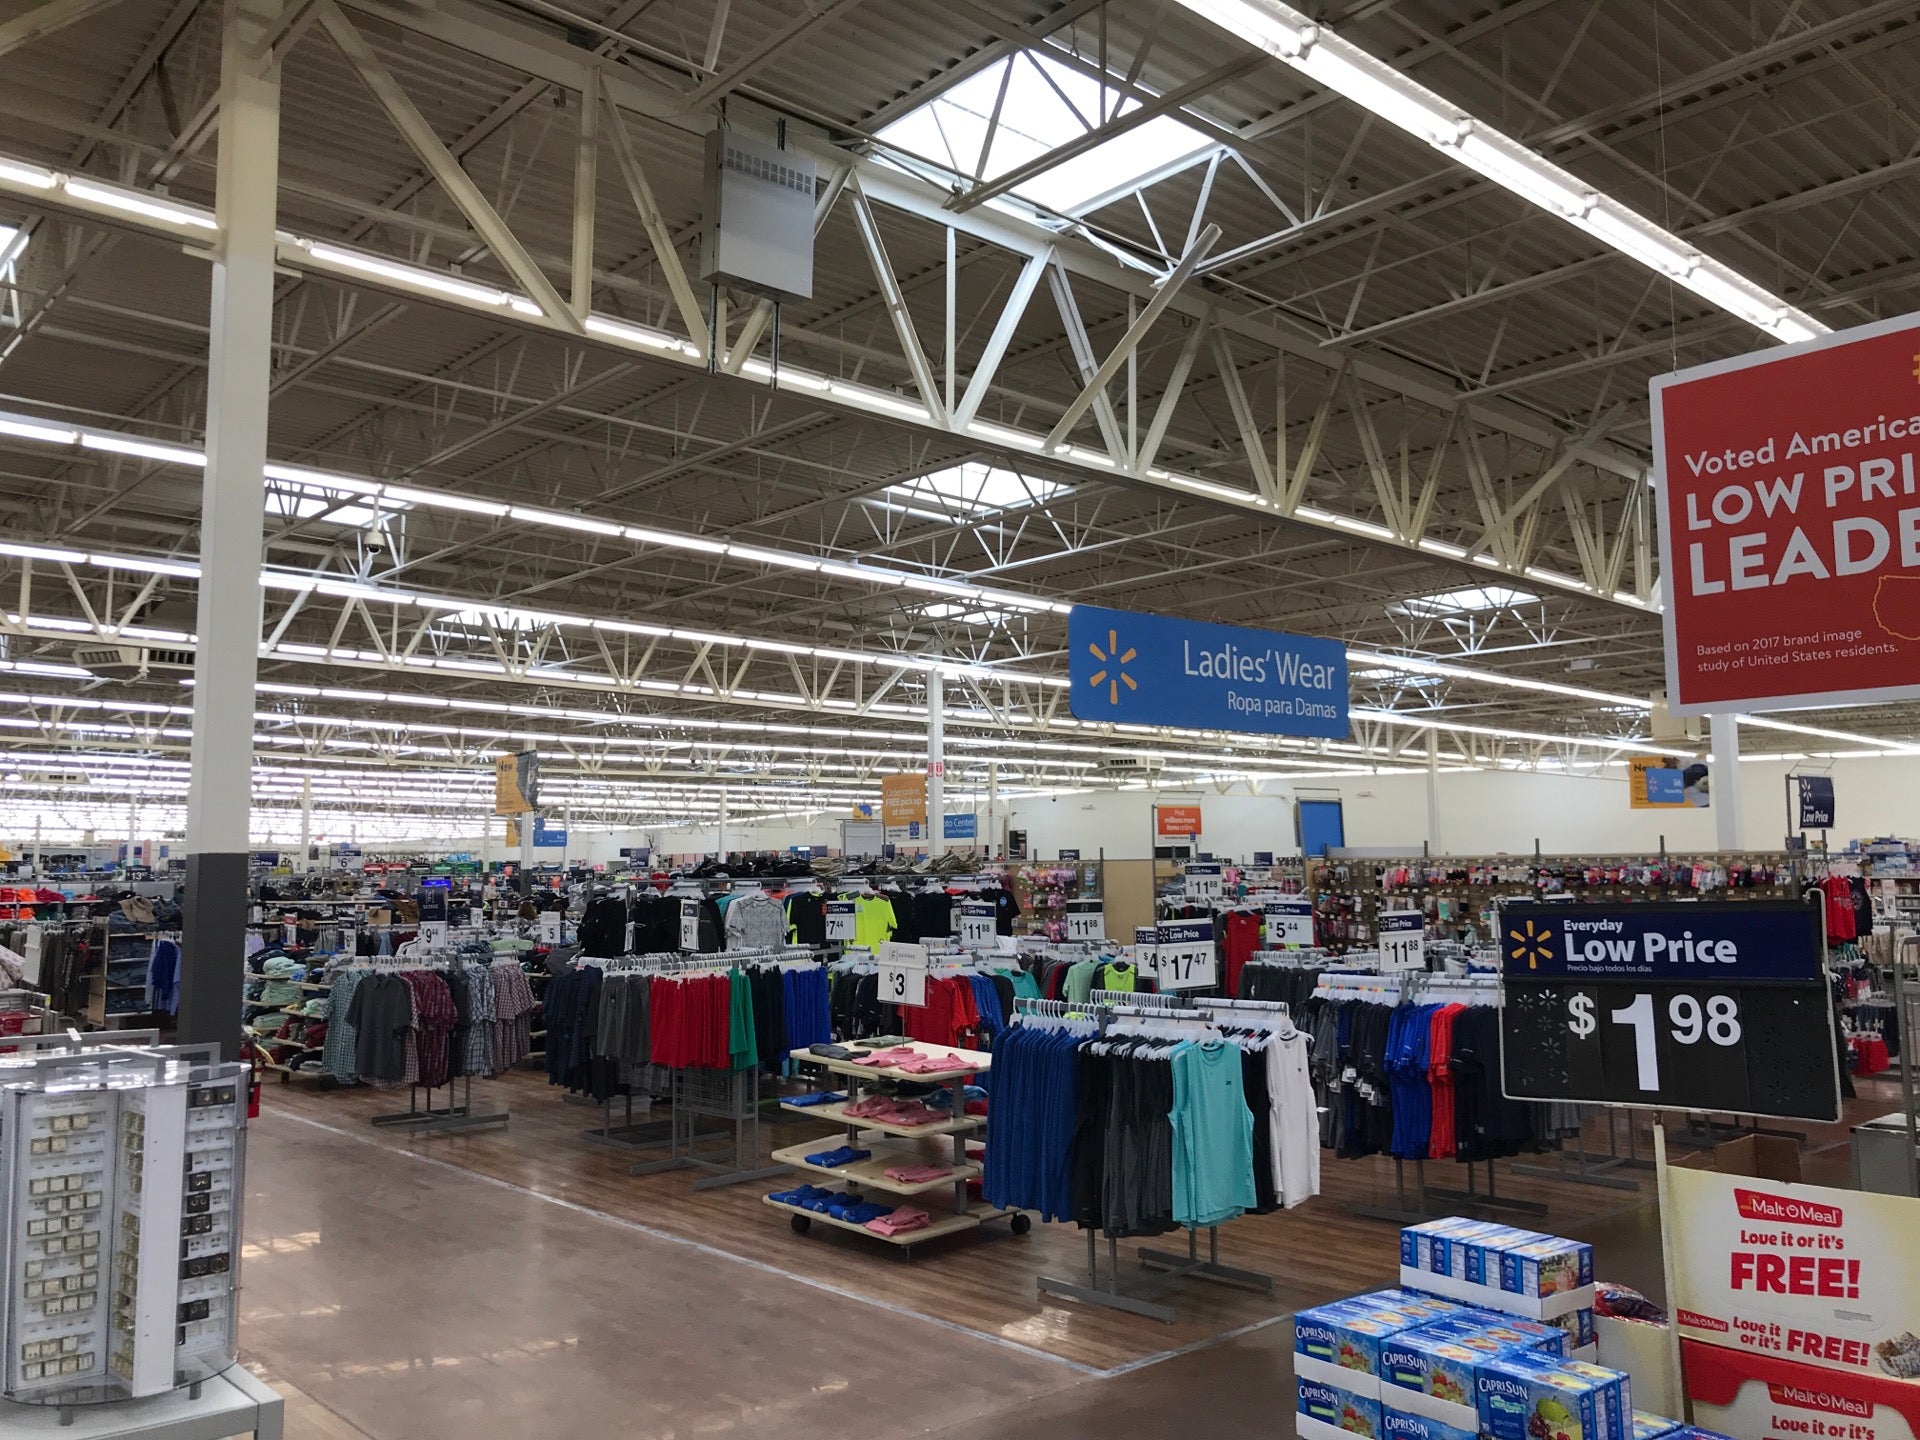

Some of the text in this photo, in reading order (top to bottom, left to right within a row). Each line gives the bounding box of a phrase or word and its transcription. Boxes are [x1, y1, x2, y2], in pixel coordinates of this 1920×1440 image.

[1685, 415, 1920, 478] Voted America
[1687, 452, 1915, 531] LOW PRI
[1697, 630, 1862, 656] Based on 2017 brand image
[1183, 639, 1335, 690] Ladies' Wear
[1697, 642, 1899, 672] study of United States residents.
[1228, 691, 1337, 719] Ropa para Damas
[953, 818, 974, 828] Center
[1803, 810, 1828, 823] Low Price
[1169, 930, 1199, 939] Low Price
[1563, 919, 1623, 934] Everyday
[1564, 931, 1737, 963] Low Price
[1567, 964, 1588, 972] Precio
[1588, 964, 1604, 973] bajo
[1605, 964, 1625, 972] todos
[1740, 1229, 1844, 1250] Love it or it's
[1730, 1251, 1861, 1299] FREE!
[1733, 1316, 1781, 1337] Love it
[1740, 1333, 1781, 1350] or it's
[1787, 1329, 1871, 1367] FREE!
[1772, 1415, 1875, 1440] Love it or it's
